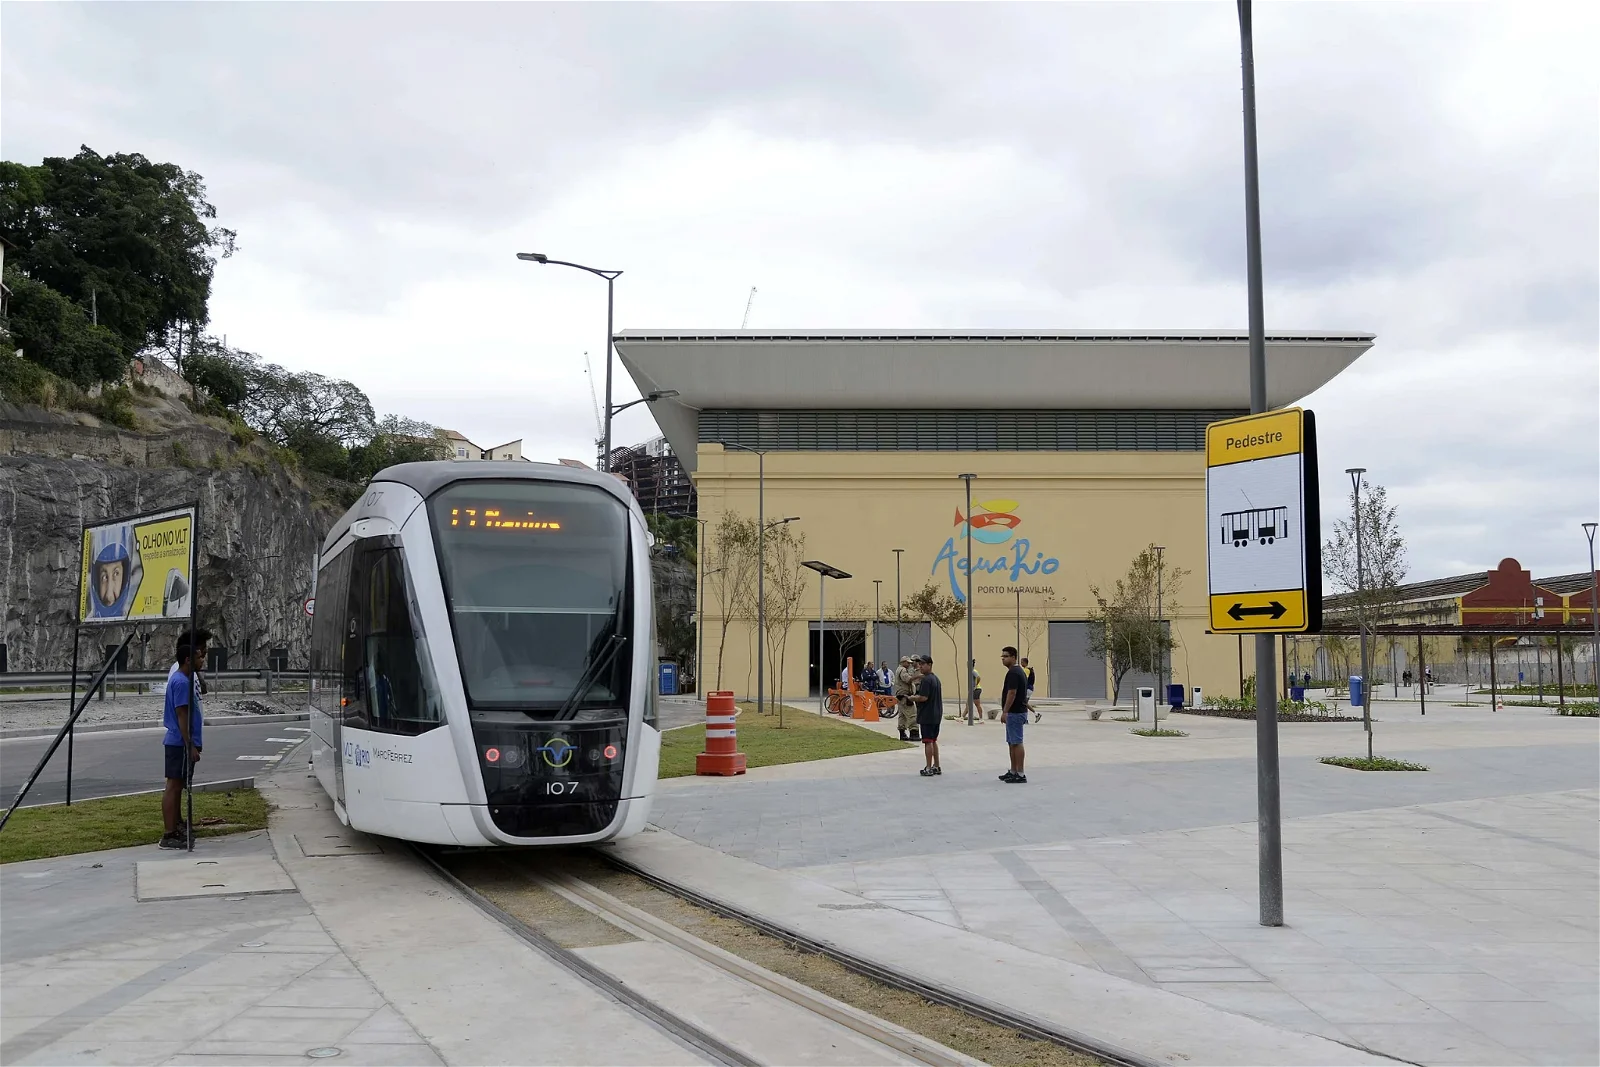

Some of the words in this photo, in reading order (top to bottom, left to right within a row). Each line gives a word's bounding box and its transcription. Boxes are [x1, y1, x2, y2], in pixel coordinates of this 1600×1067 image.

[1226, 431, 1283, 450] Pedestre
[142, 533, 162, 550] OLHO
[163, 530, 174, 547] NO
[175, 528, 188, 544] VLT
[978, 586, 1005, 594] PORTO
[1006, 586, 1054, 594] MARAVILHA
[546, 781, 580, 795] 107
